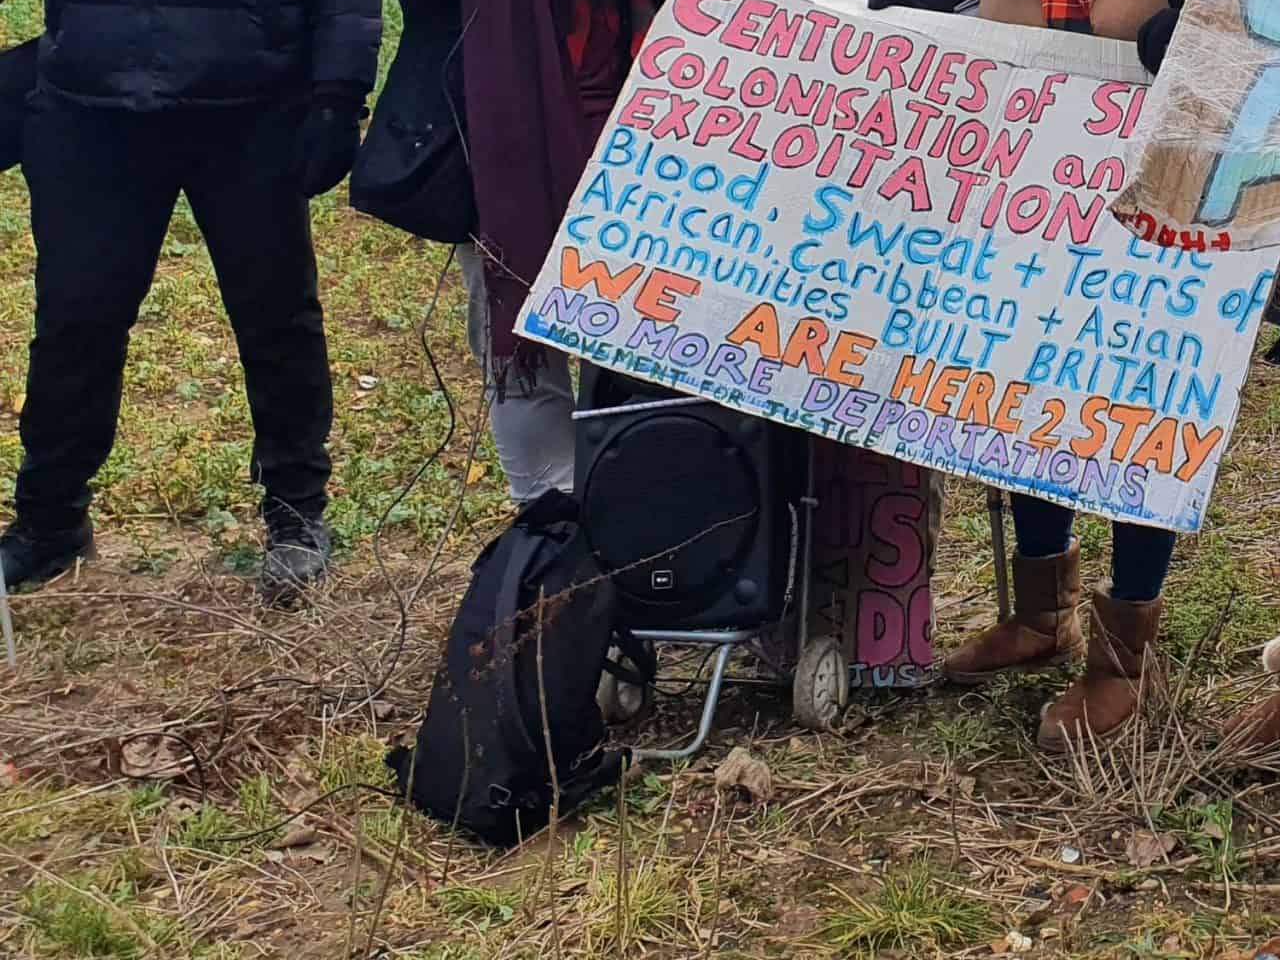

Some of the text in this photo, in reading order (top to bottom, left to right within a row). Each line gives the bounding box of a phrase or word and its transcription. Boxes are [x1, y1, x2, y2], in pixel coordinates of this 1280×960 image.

[617, 87, 1106, 244] EXPLOITATION
[639, 35, 1033, 178] COLONISATION
[601, 125, 779, 222] Blood,
[802, 183, 999, 283] Sweat
[1014, 251, 1046, 289] +
[1064, 243, 1207, 318] Tears
[560, 246, 1225, 483] WE ARE HERE 2 STAY
[790, 237, 1019, 330] Caribbean
[1037, 306, 1064, 337] +
[1075, 303, 1204, 368] Asian
[879, 307, 1013, 369] BUILT
[1023, 340, 1222, 420] BRITAIN
[538, 286, 621, 338] NO
[625, 316, 785, 395] MORE
[800, 376, 1149, 509] DEPORTATIONS
[547, 321, 880, 448] MOVEMENT FOR JUSTICE
